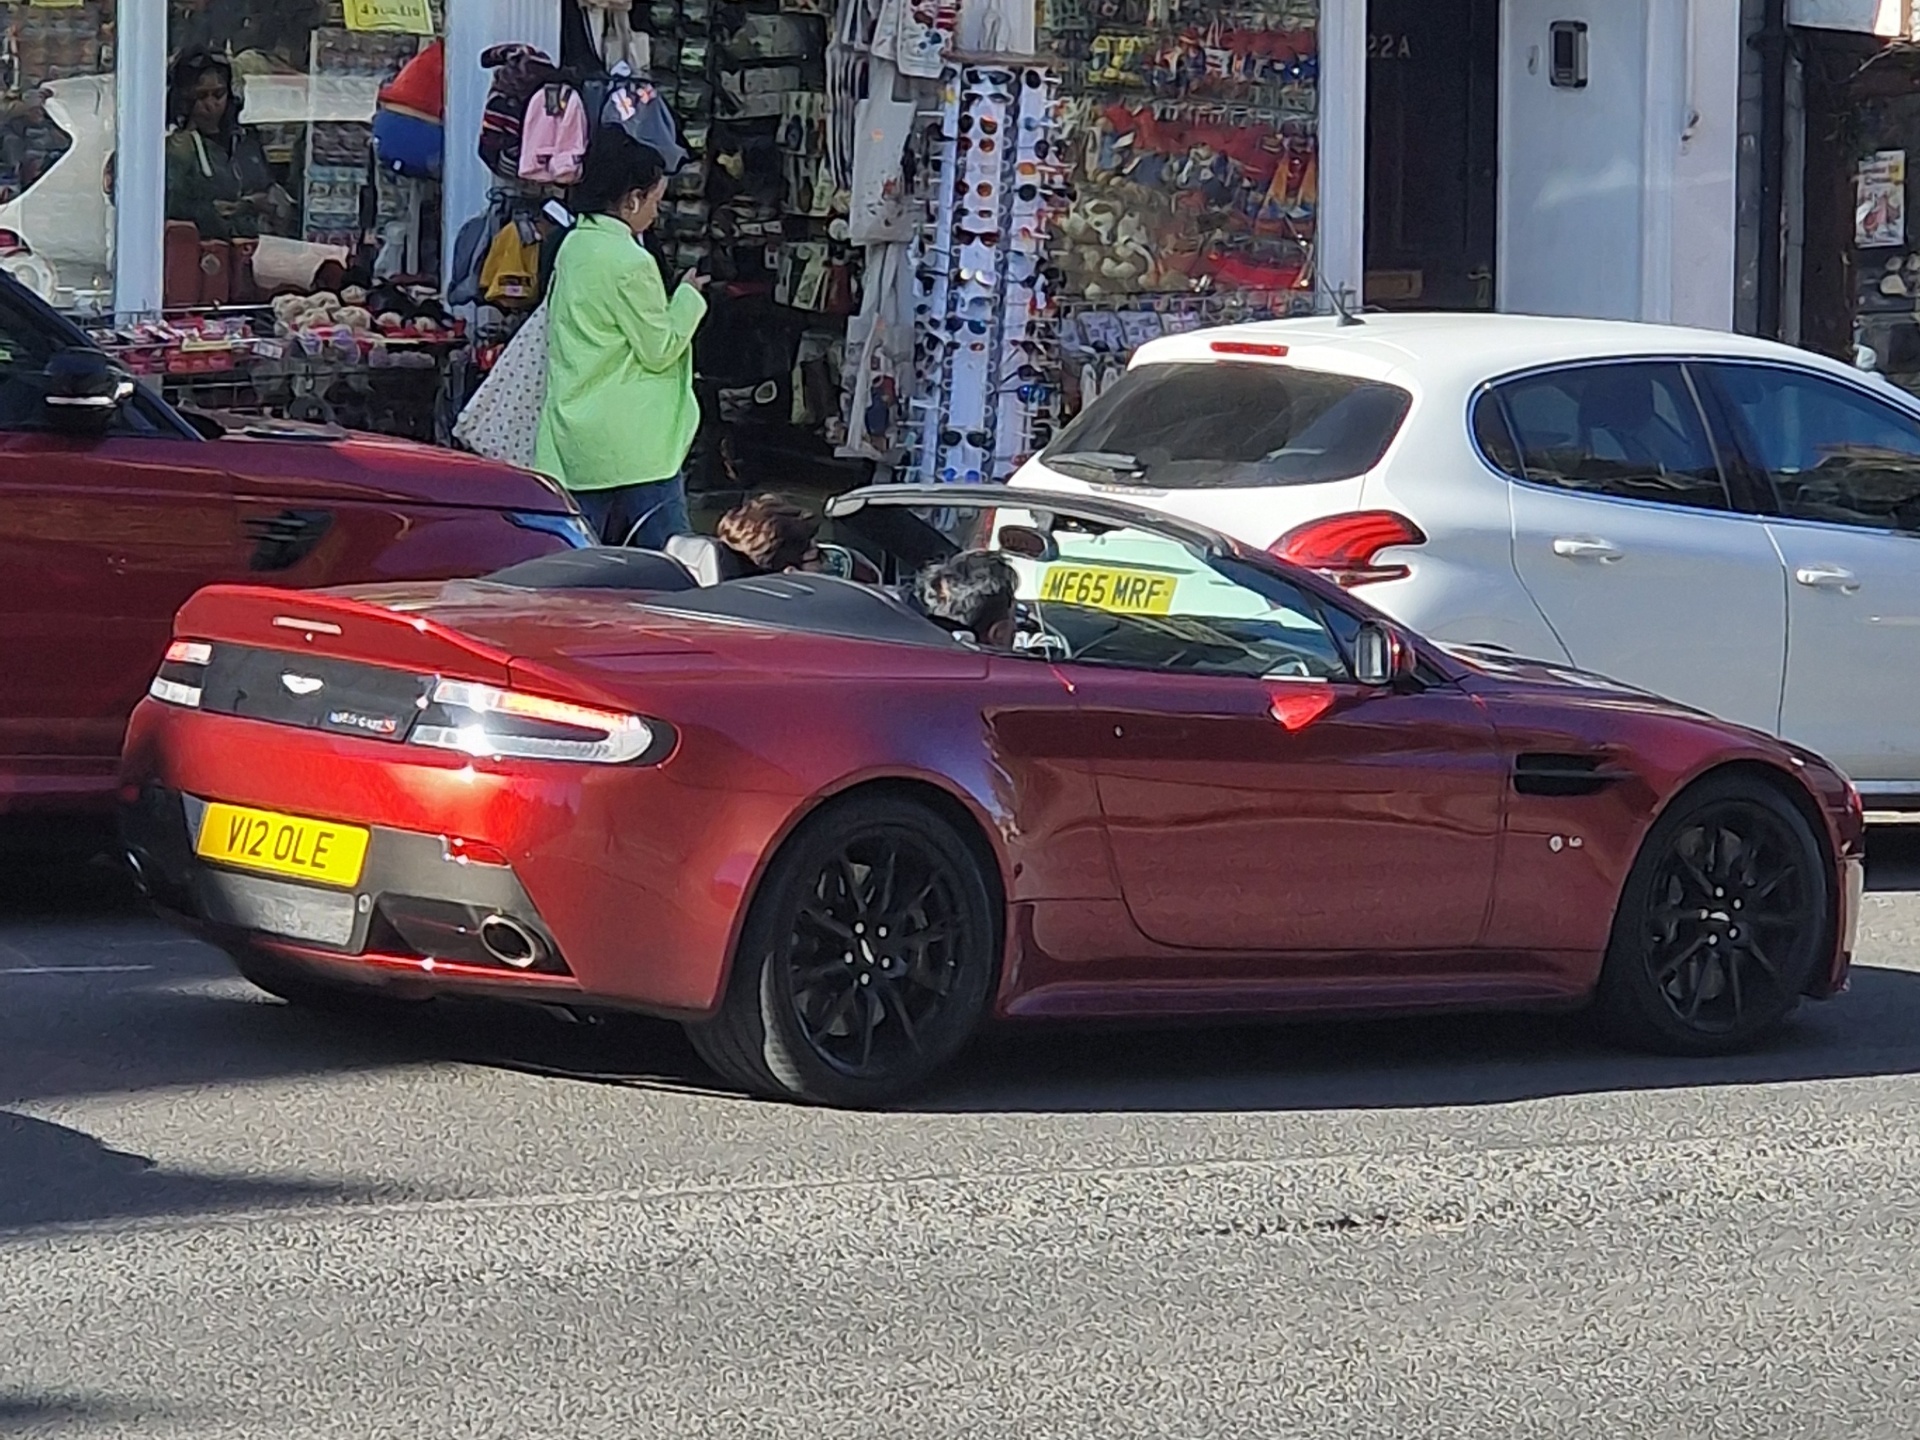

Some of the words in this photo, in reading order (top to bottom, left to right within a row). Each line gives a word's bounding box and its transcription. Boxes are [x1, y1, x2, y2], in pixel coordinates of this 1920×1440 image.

[1048, 571, 1109, 604] MF65
[1111, 575, 1166, 609] MRF
[227, 814, 270, 857] V12
[273, 824, 335, 869] OLE
